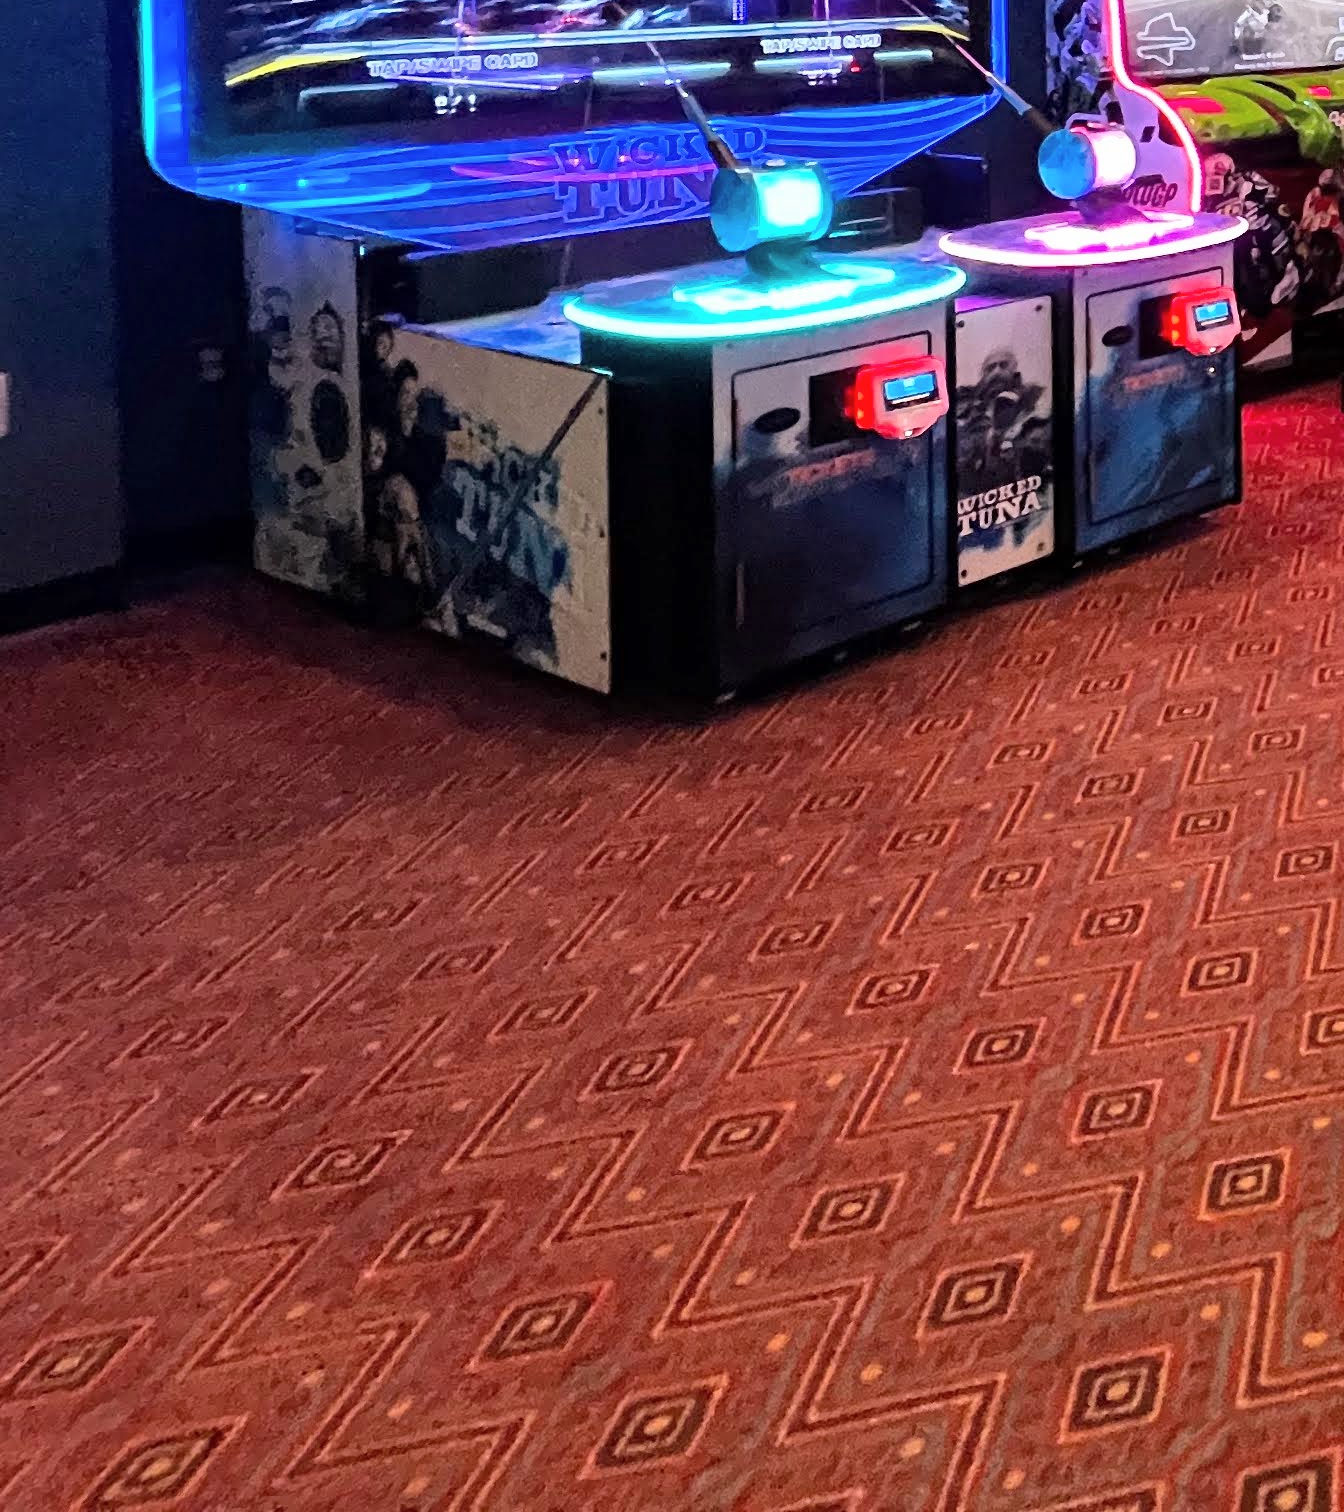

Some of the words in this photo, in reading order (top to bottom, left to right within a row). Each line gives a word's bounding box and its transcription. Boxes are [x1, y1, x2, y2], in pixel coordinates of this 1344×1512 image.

[550, 127, 767, 176] WICKD
[554, 169, 713, 224] TUN
[957, 475, 1042, 516] WICKED
[957, 491, 1043, 536] TUNA
